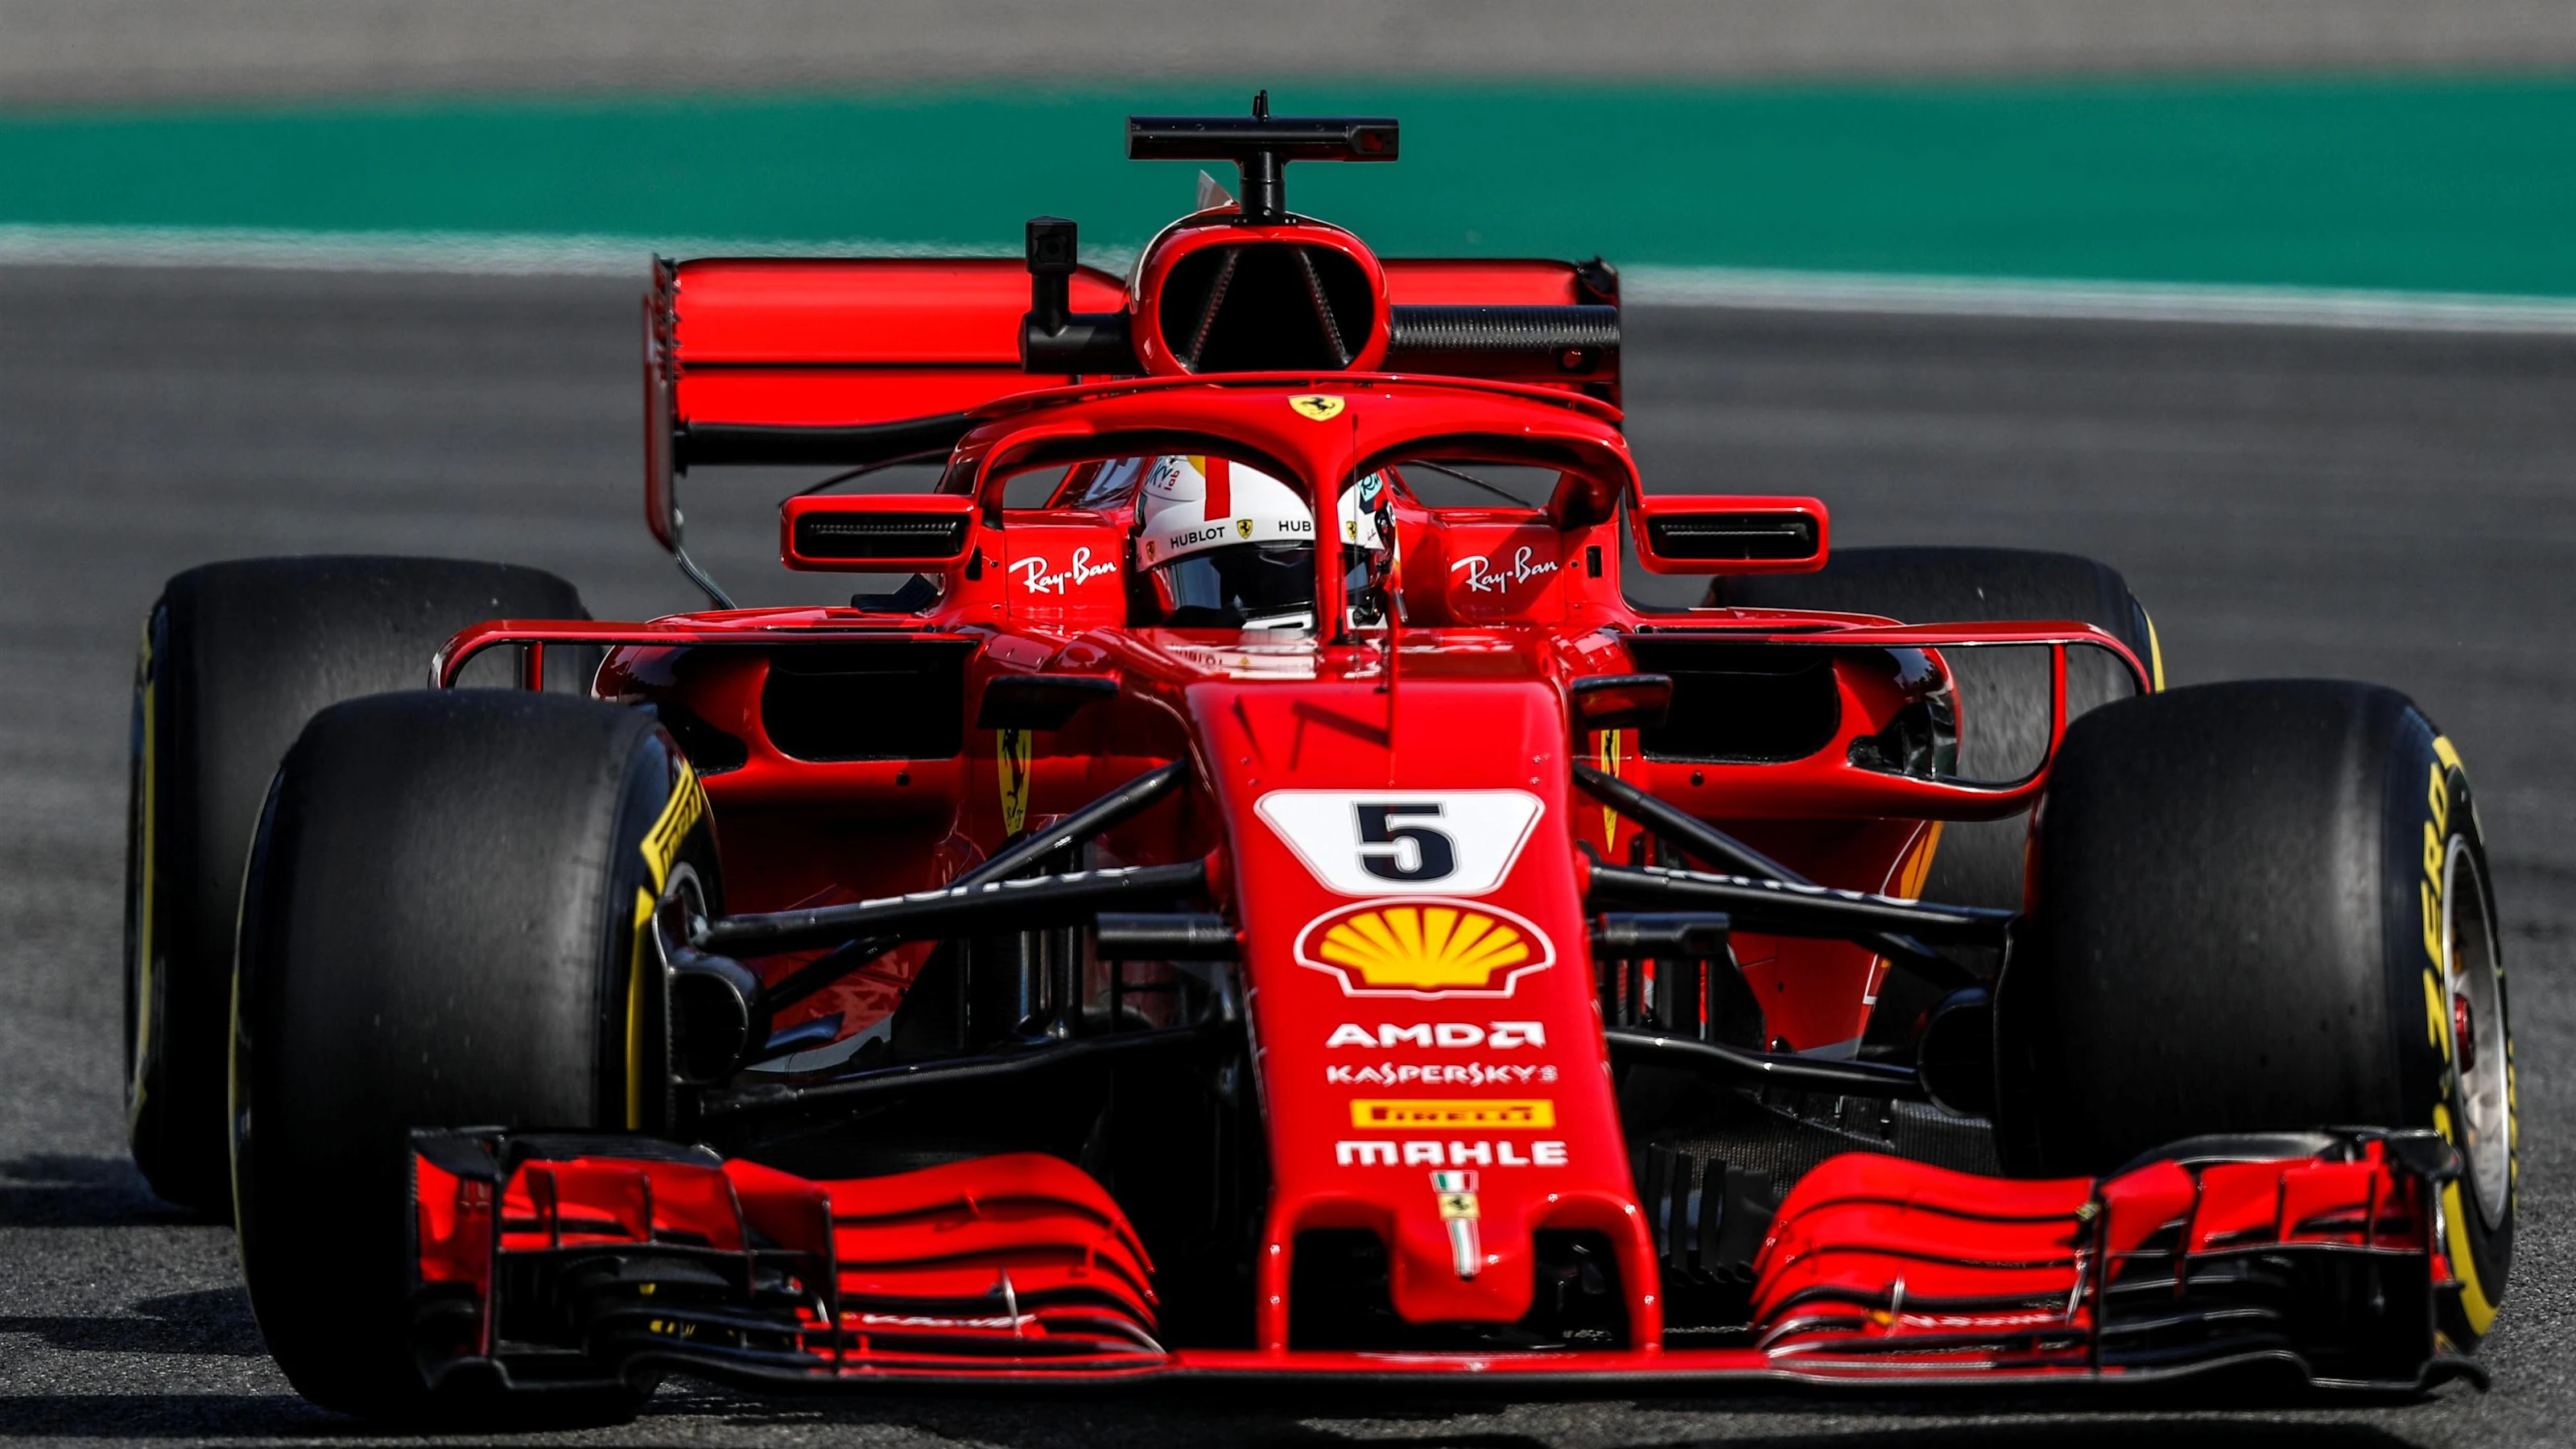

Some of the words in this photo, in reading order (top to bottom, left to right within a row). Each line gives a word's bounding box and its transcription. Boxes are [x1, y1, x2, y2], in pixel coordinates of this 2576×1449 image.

[1170, 526, 1225, 549] HUBLOT
[1352, 800, 1459, 884] 5
[1326, 1023, 1486, 1048] AMD
[1326, 1062, 1537, 1087] KASPERSKY
[1336, 1141, 1568, 1166] MAHLE
